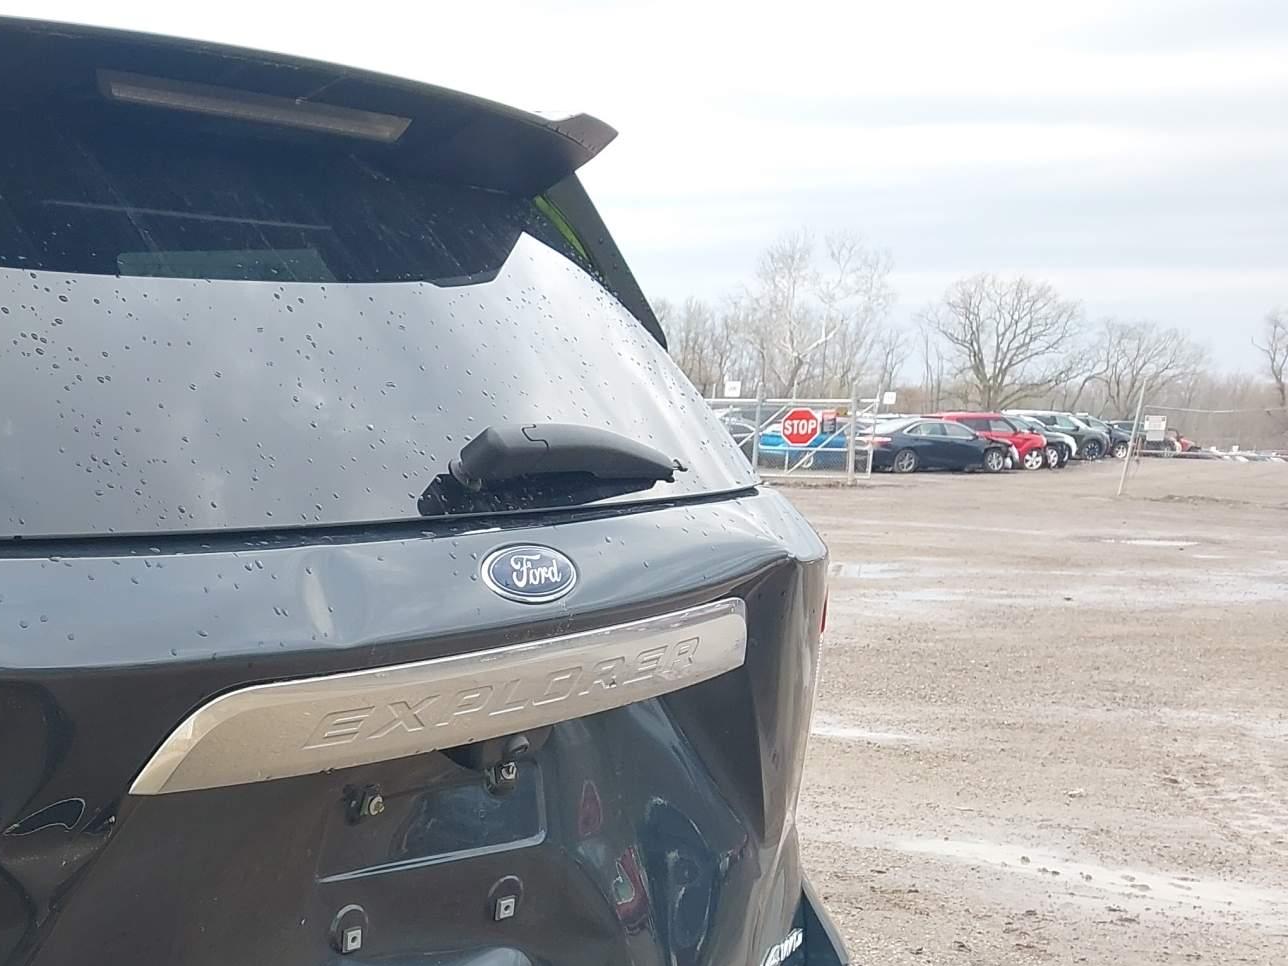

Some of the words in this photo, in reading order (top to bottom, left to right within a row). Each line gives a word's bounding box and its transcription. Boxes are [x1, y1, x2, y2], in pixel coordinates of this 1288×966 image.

[783, 419, 817, 435] STOP
[510, 554, 562, 588] Ford
[302, 636, 701, 750] EXPLORER
